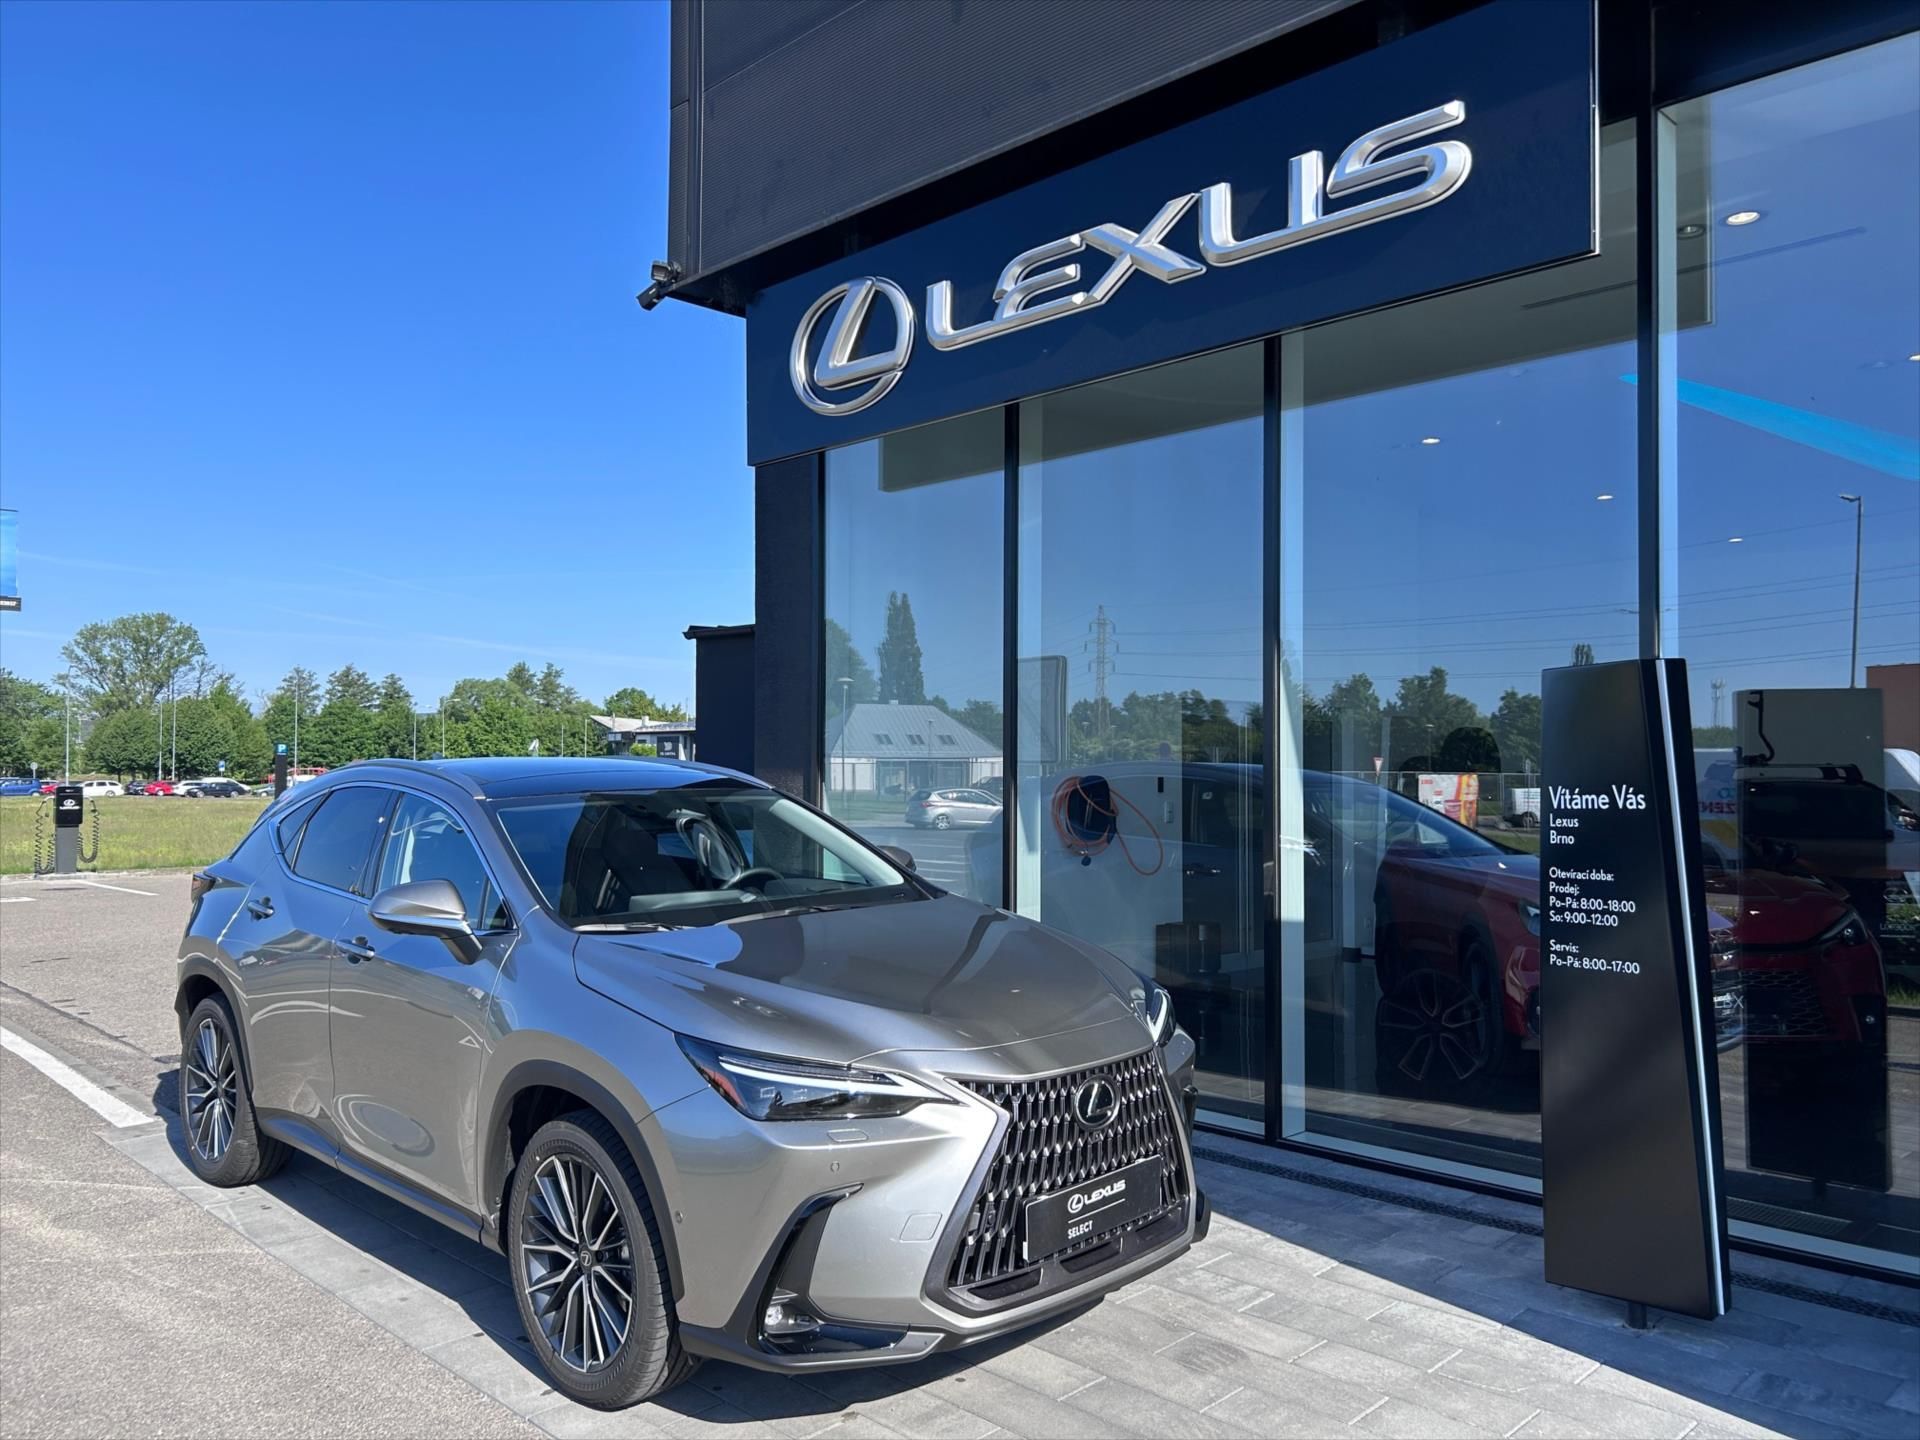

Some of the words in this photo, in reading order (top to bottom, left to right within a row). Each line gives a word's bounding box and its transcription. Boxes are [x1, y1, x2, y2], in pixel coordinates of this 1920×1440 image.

[924, 99, 1473, 352] LEXUS
[277, 743, 287, 753] P
[1548, 785, 1610, 810] Vítáme
[1611, 784, 1647, 810] Vás
[1549, 813, 1579, 828] Lexus
[1549, 830, 1575, 844] Brno
[1590, 868, 1614, 881] doba:
[1549, 881, 1580, 896] Prodej:
[1549, 910, 1563, 922] So:
[1549, 939, 1579, 953] Servis:
[1084, 1179, 1126, 1205] LEXUS
[1068, 1220, 1093, 1239] SELECT
